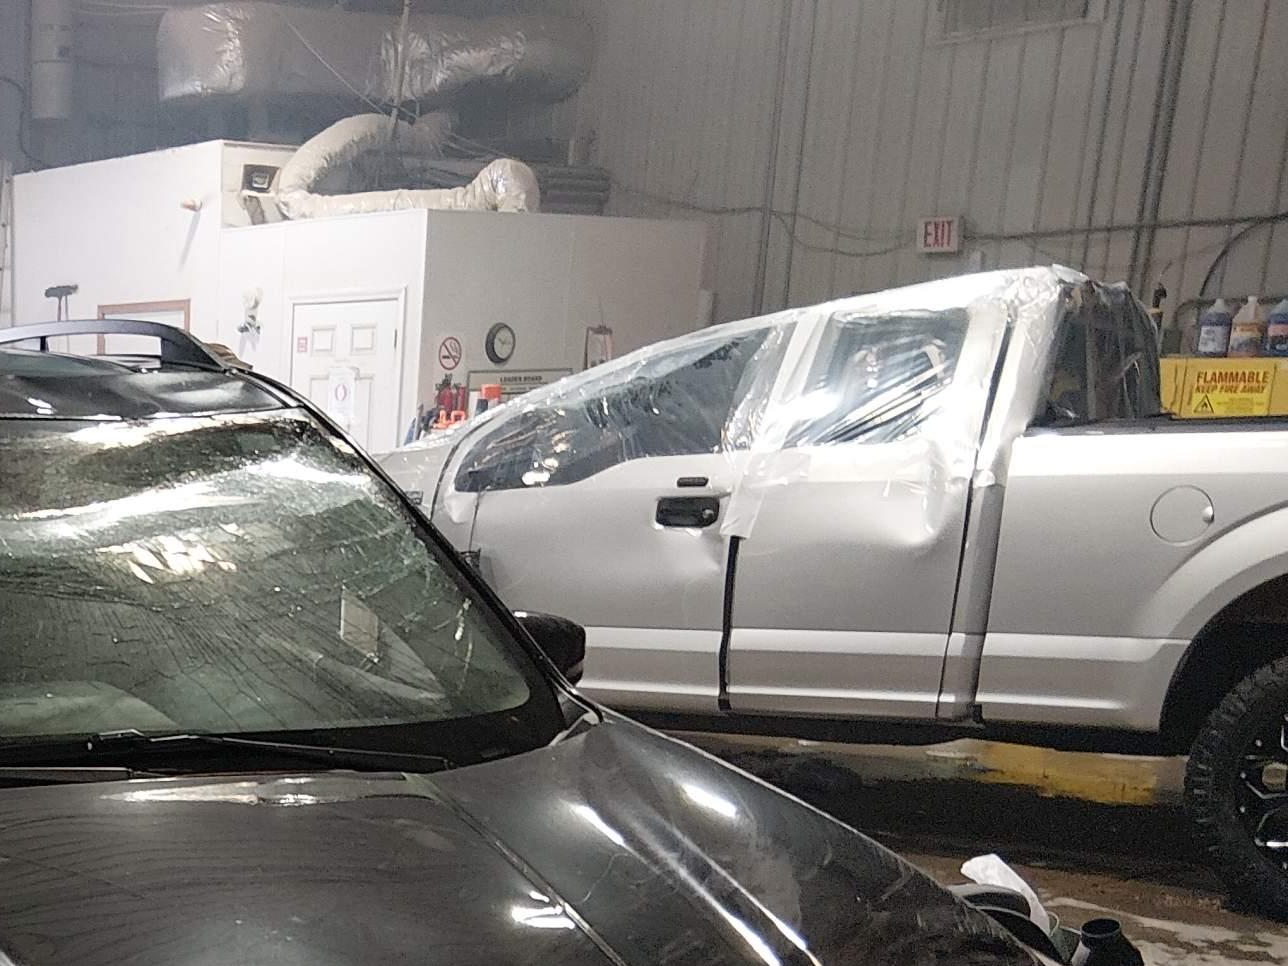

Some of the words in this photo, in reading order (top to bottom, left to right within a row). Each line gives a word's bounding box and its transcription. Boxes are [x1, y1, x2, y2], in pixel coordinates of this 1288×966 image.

[923, 220, 953, 248] EXIT
[1196, 371, 1270, 384] FLAMMABLE
[1195, 384, 1217, 394] KEEP
